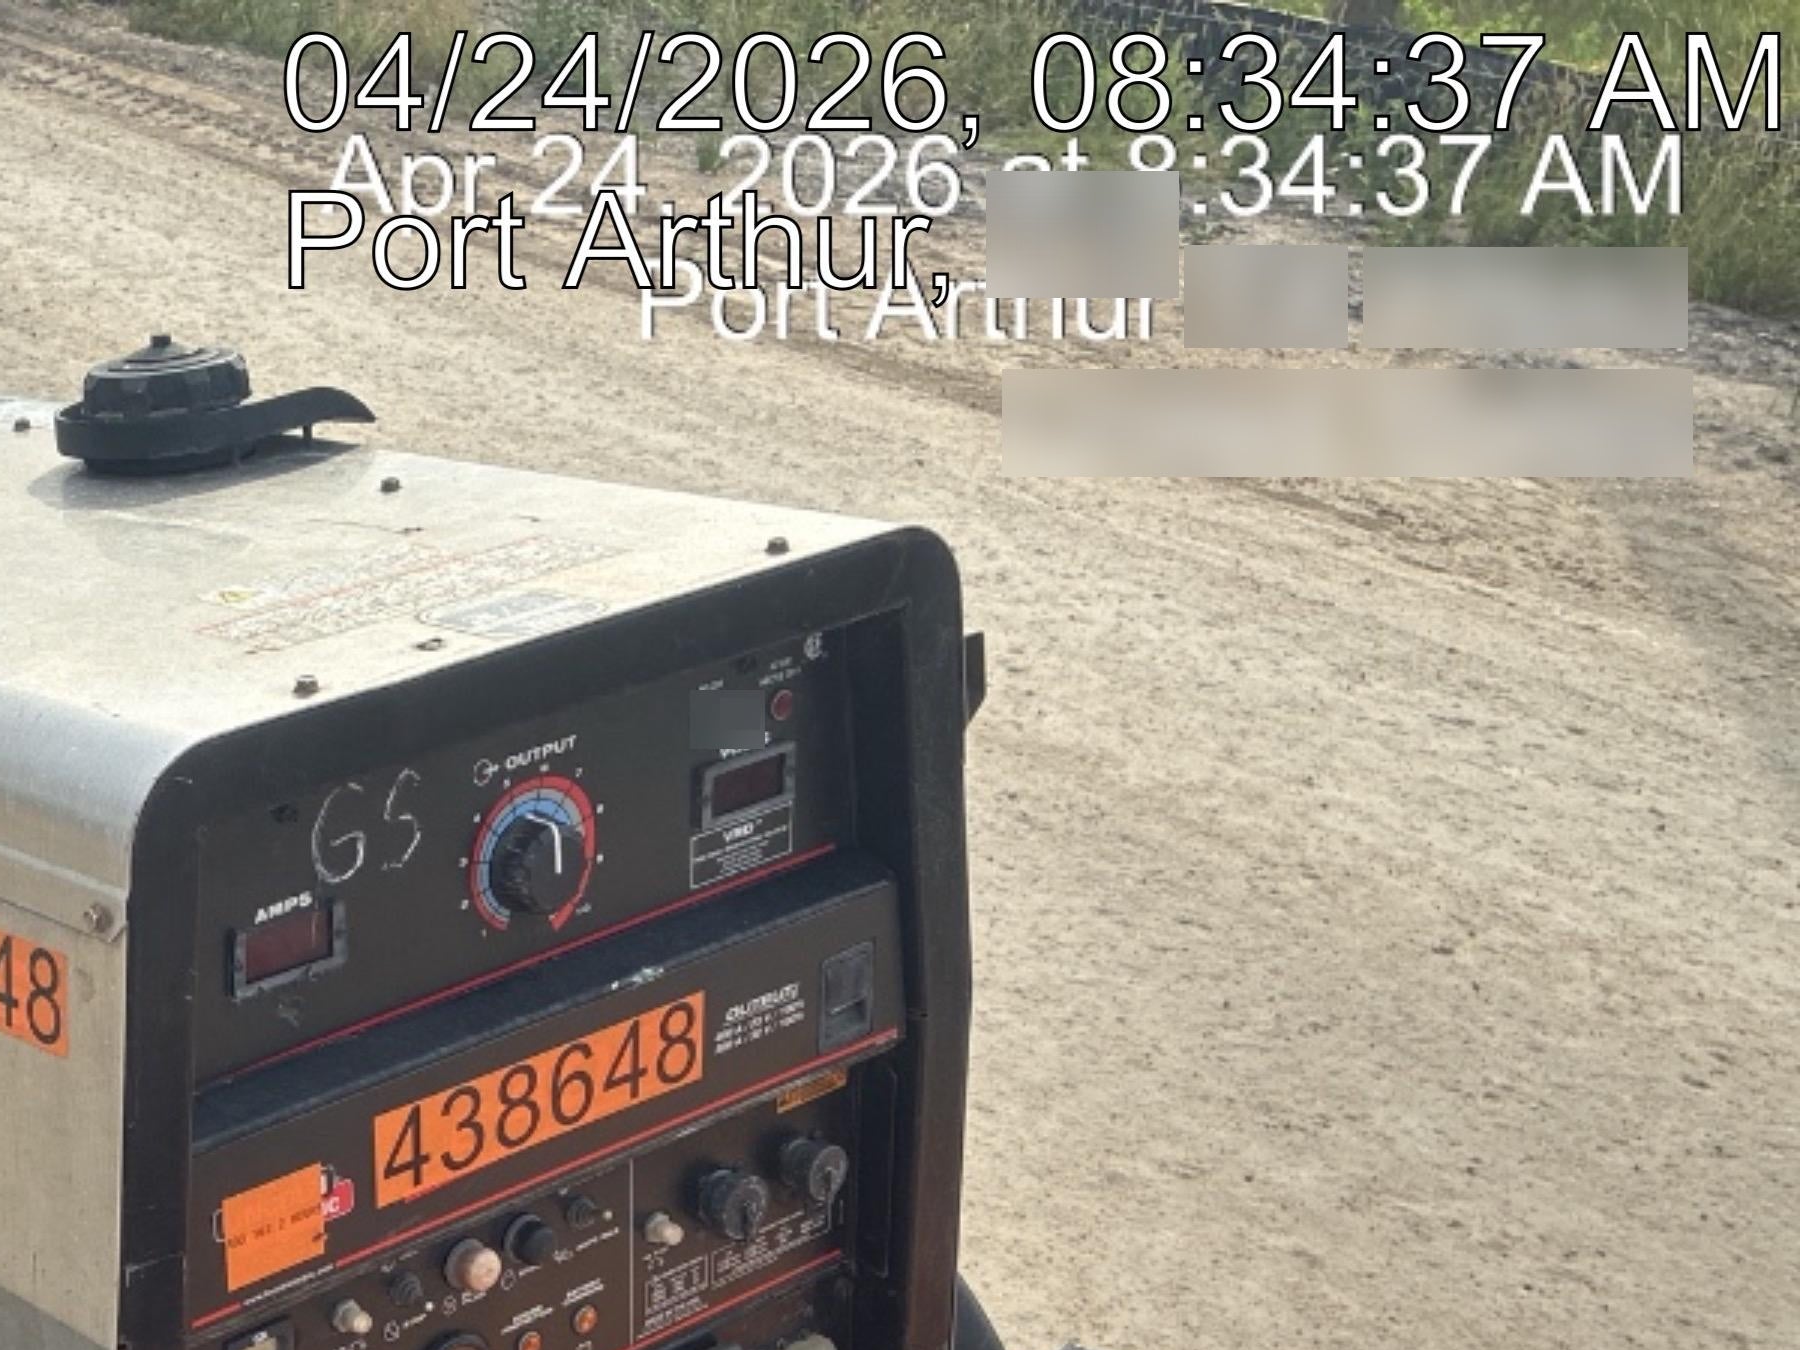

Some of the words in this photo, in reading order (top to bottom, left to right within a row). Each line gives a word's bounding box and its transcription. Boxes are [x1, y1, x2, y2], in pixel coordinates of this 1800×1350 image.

[505, 733, 578, 770] OUTPUT
[254, 890, 314, 925] AMPS
[383, 1001, 697, 1186] 438648
